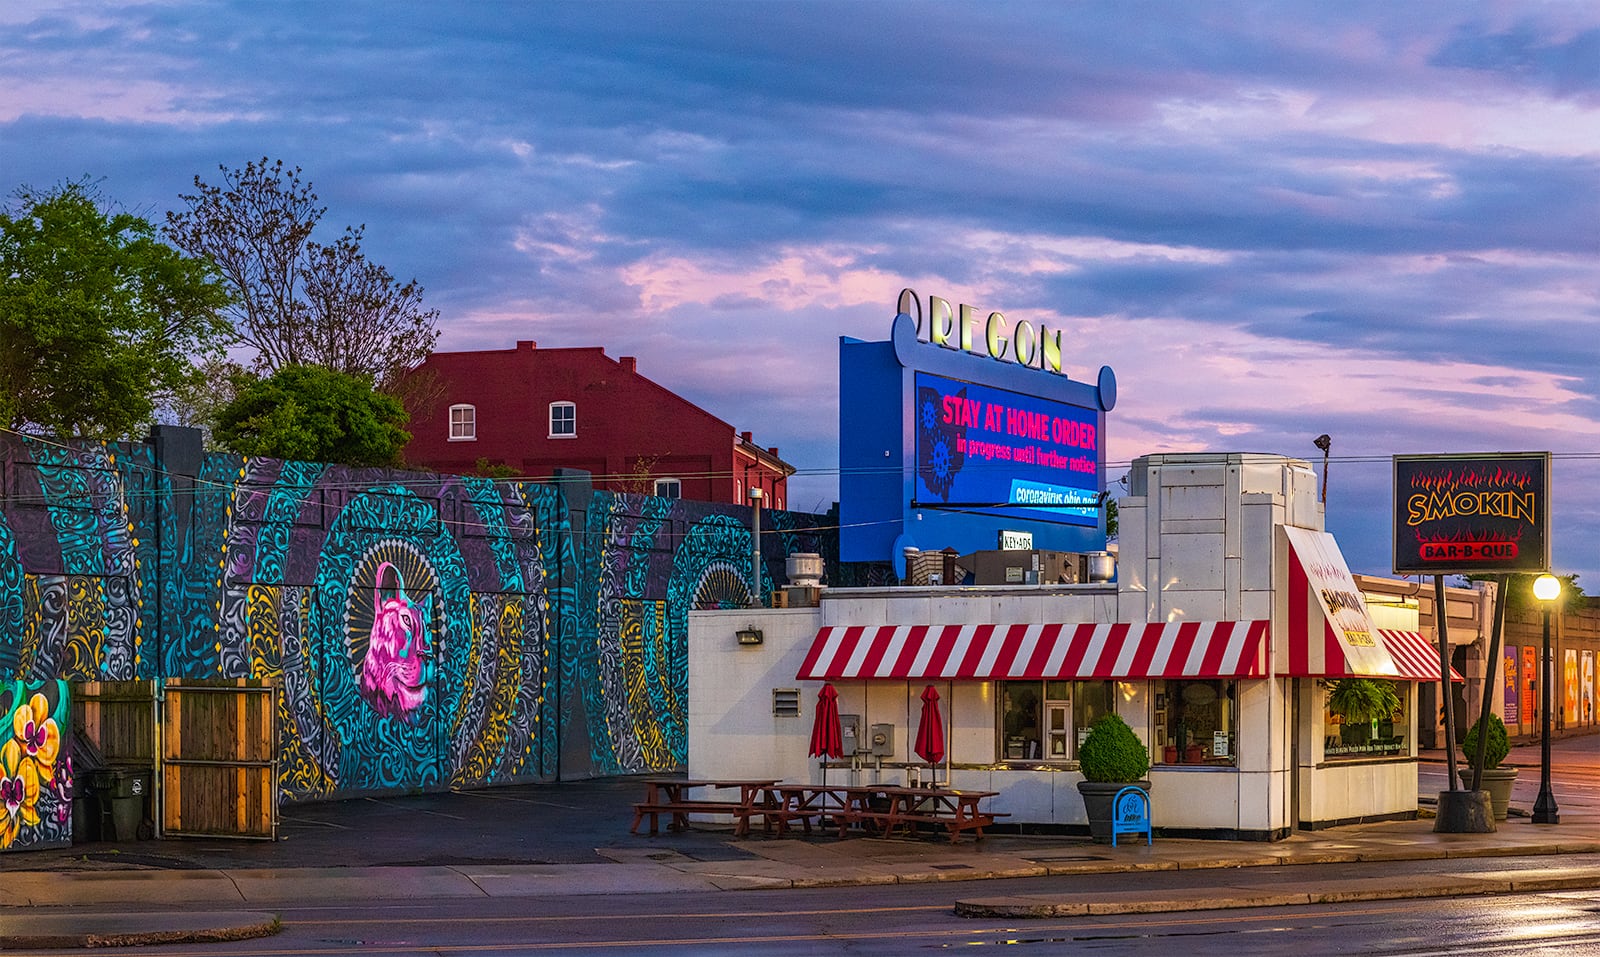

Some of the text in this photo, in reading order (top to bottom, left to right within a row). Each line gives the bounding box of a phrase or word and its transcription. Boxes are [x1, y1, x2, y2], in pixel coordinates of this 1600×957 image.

[897, 288, 1062, 373] OREGON
[942, 394, 1096, 450] STAY AT HOME ORDER
[956, 433, 1096, 474] in progress until further notice
[1407, 490, 1535, 526] SMOKIN
[1425, 544, 1513, 559] BAR-B-QUE
